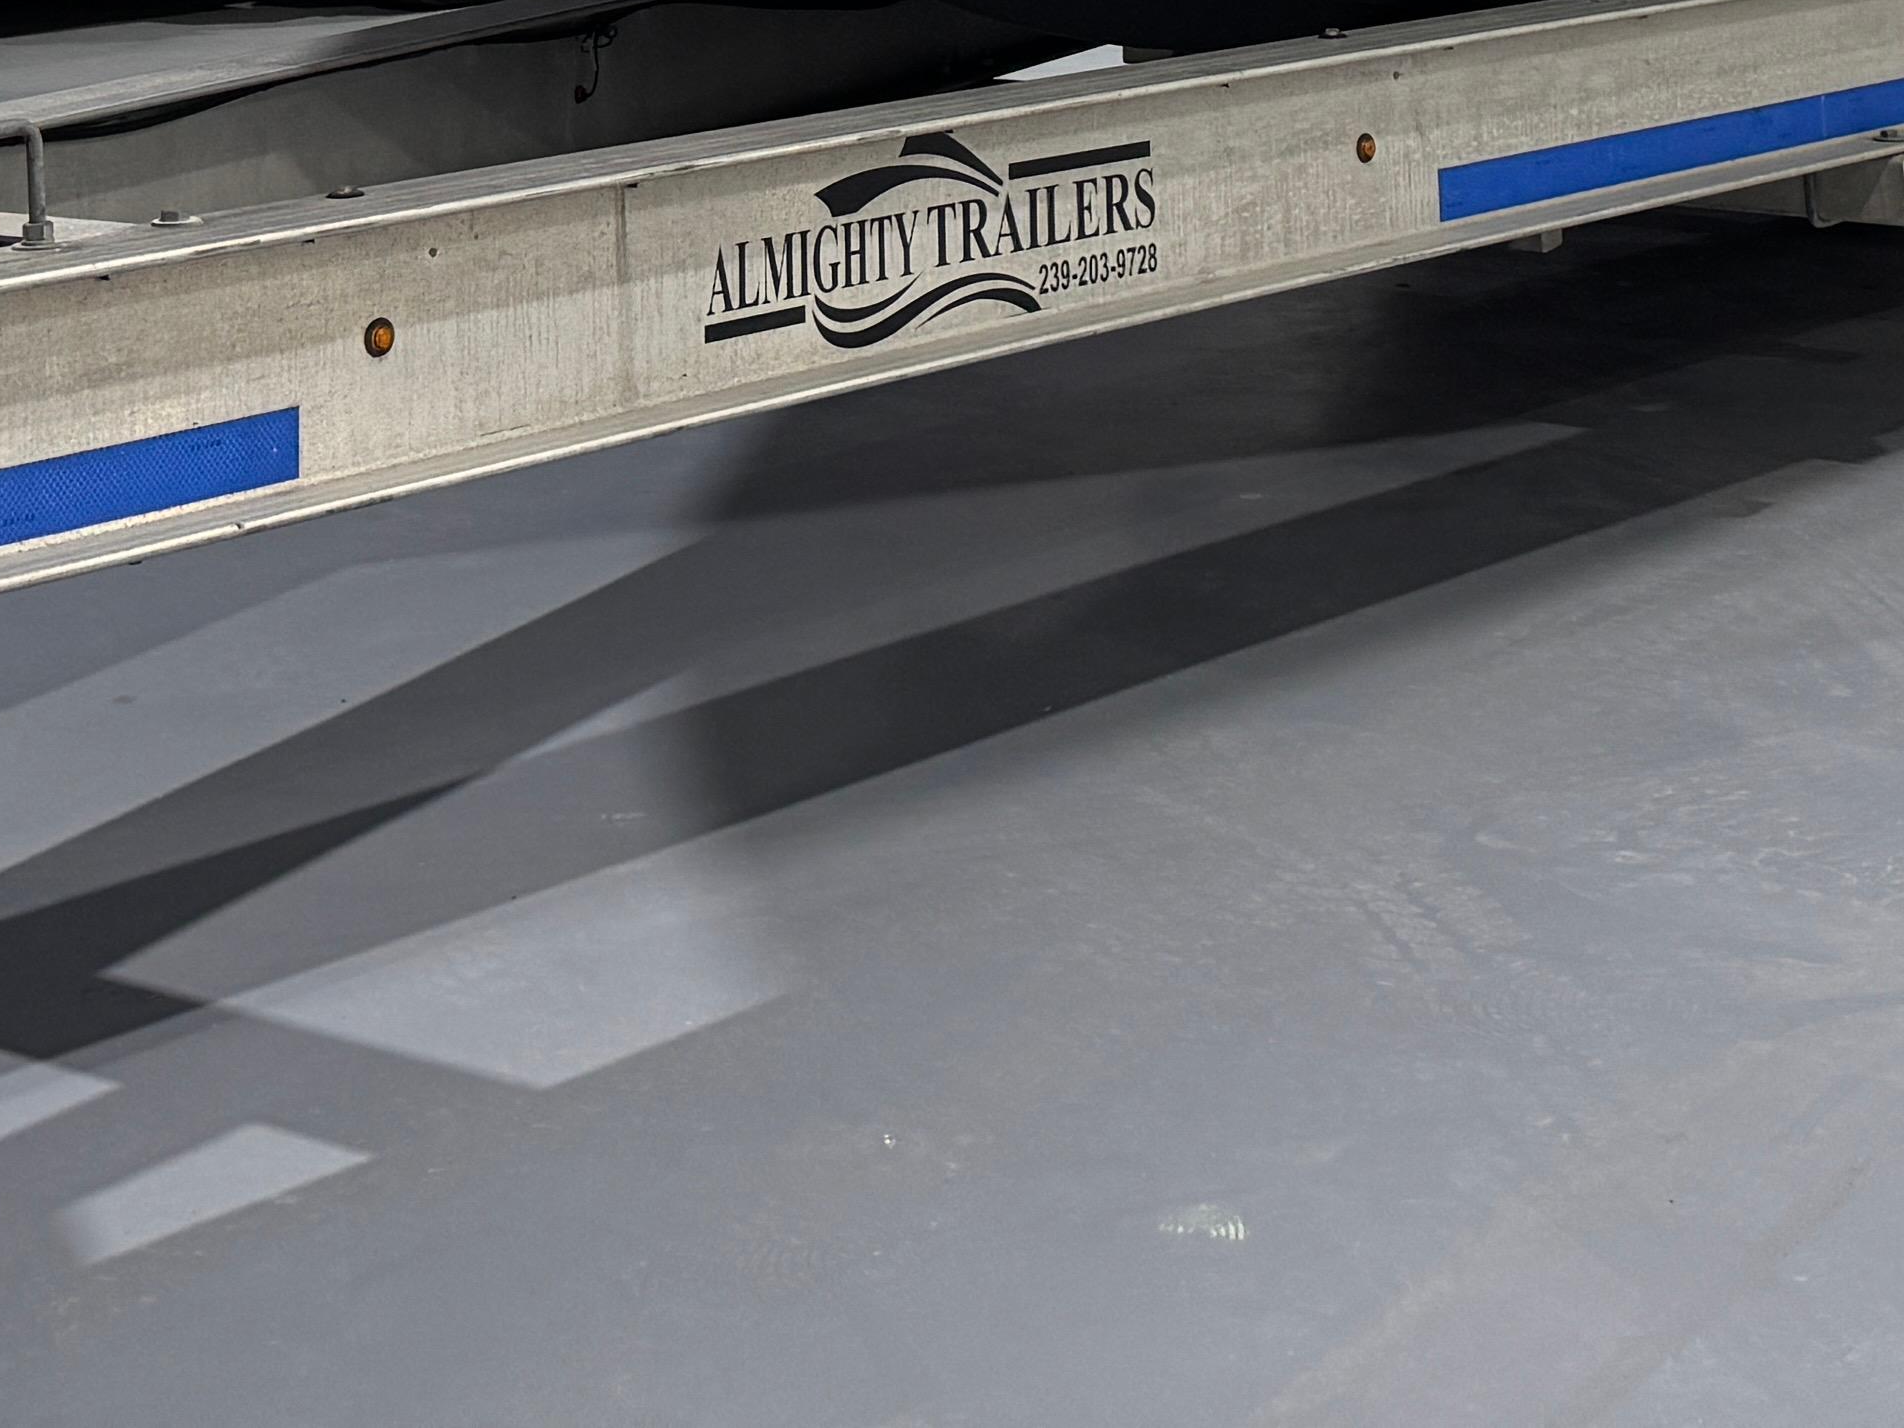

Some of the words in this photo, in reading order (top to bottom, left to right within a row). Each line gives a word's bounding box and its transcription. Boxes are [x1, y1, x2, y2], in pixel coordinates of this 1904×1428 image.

[707, 210, 919, 316] ALMIGHTY
[927, 168, 1156, 267] TRAILERS
[1039, 243, 1158, 295] 239-203-9728
